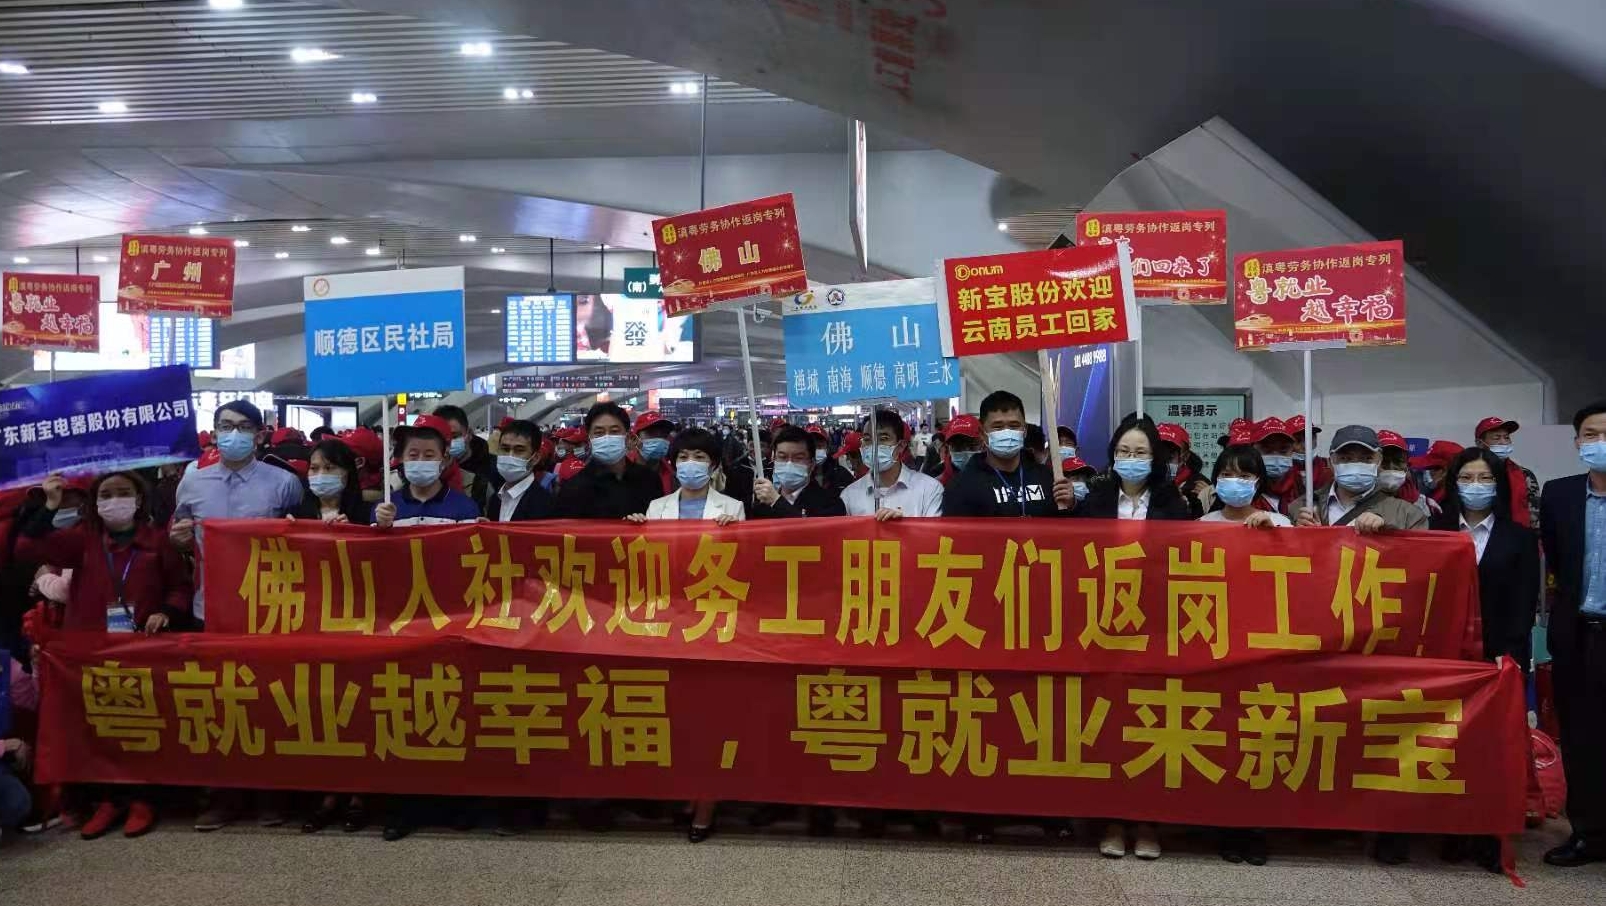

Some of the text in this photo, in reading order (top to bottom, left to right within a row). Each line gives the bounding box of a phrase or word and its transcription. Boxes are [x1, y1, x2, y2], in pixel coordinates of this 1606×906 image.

[151, 259, 202, 283] 广州
[698, 240, 761, 274] 佛山
[1261, 252, 1391, 275] 滇粤劳务协作返岗专列
[957, 274, 1114, 313] 新宝股份欢迎
[1246, 274, 1334, 305] 粤就业
[961, 306, 1118, 344] 云南员工回家
[1300, 294, 1394, 326] 越幸福
[313, 320, 455, 357] 顺德区民社局
[819, 315, 921, 356] 佛山
[793, 357, 953, 397] 禅城 南海 顺德 高明 三水
[0, 398, 190, 447] 东新宝电器股份有限公司
[1168, 404, 1218, 417] 温馨提示
[238, 534, 1438, 660] 佛山人社欢迎务工朋友们返岗工作!
